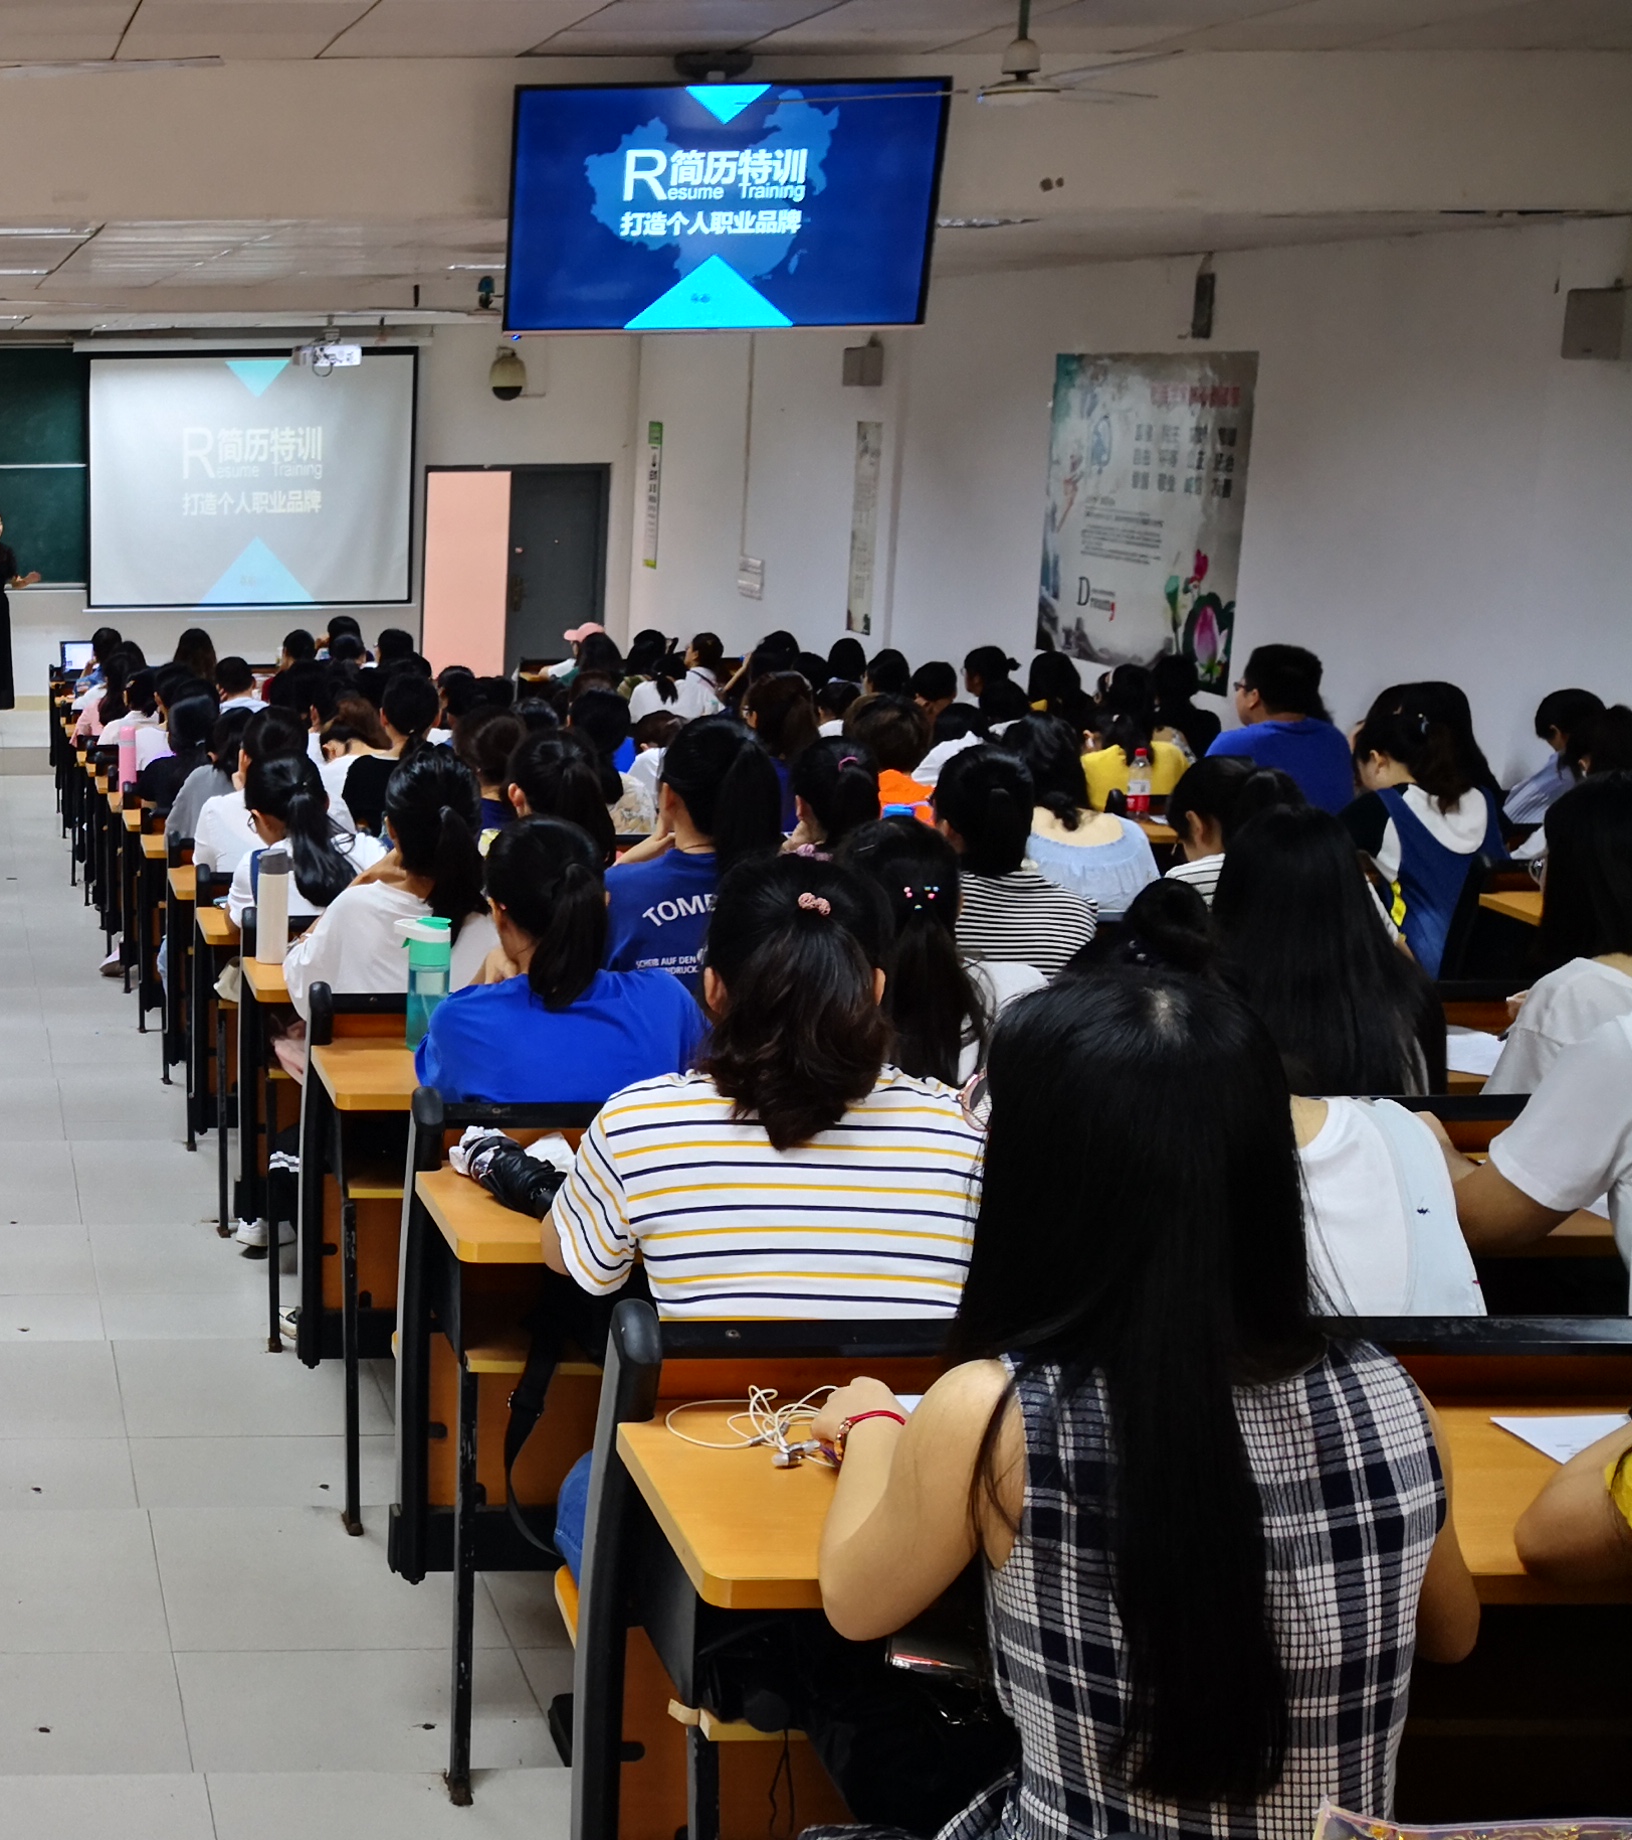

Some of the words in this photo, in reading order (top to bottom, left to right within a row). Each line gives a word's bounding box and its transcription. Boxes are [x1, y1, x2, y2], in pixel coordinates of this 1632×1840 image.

[670, 148, 808, 186] 简历特训
[738, 182, 805, 202] Training
[619, 209, 803, 236] 打造个人职业品牌
[217, 426, 322, 463] 简历特训
[272, 461, 323, 480] Training
[182, 489, 322, 516] 打造个人职业品牌
[661, 957, 677, 966] AUF
